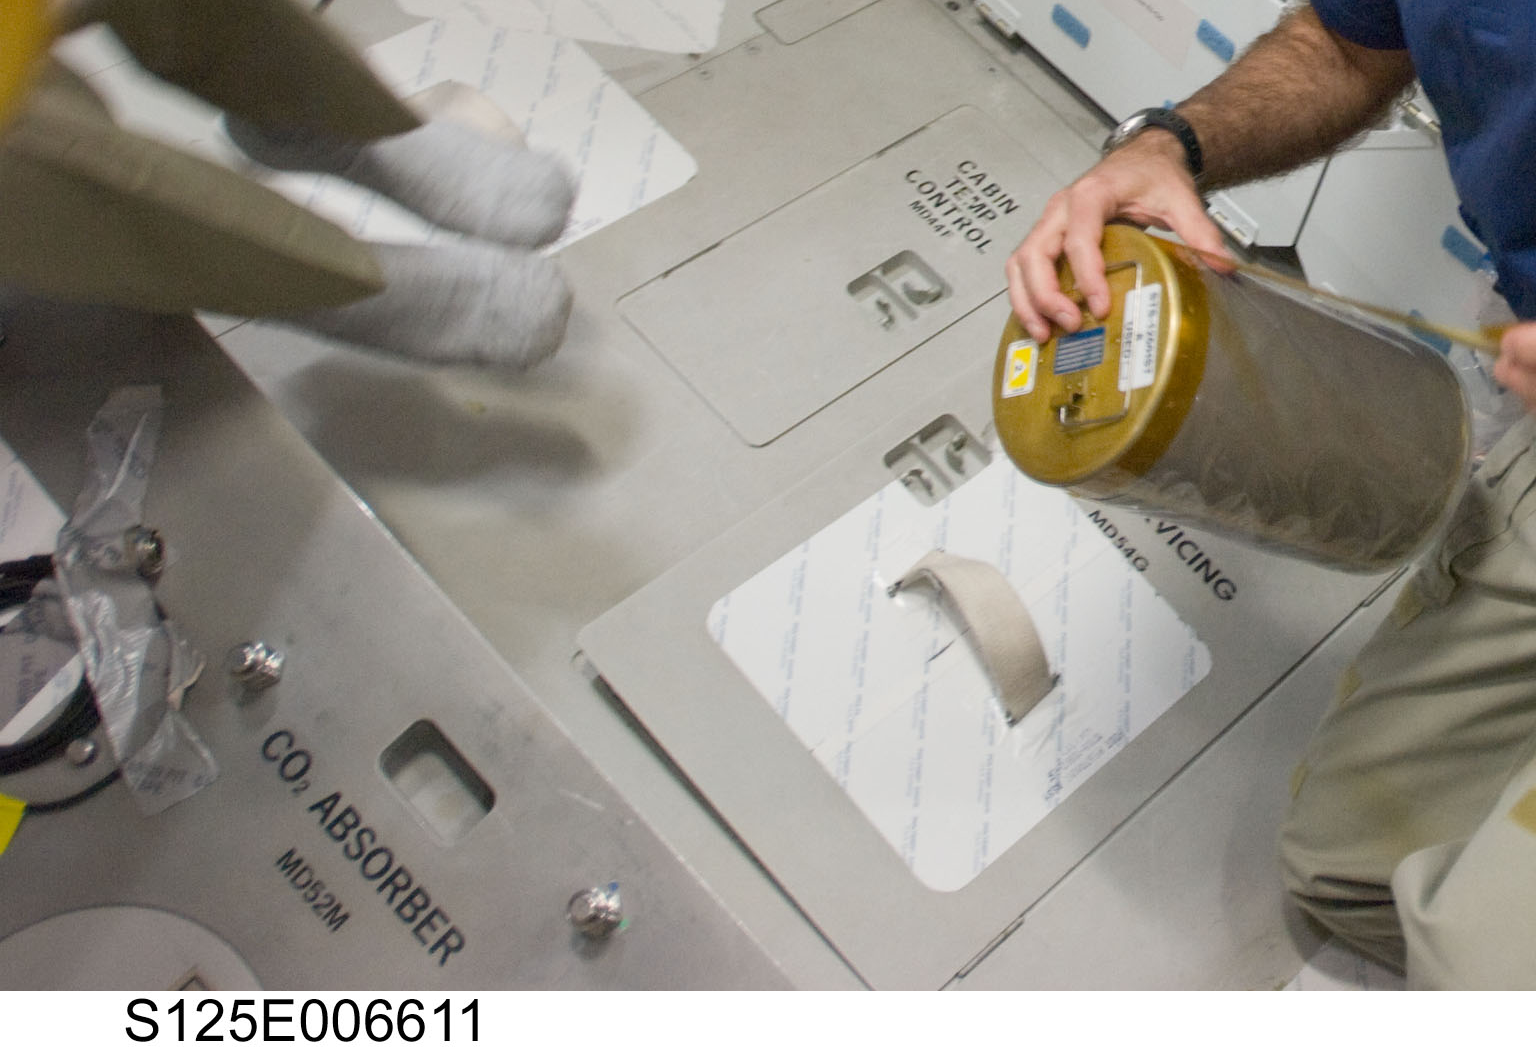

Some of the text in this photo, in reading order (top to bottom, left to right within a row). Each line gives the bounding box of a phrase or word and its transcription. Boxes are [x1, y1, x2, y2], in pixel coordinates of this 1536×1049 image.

[904, 169, 992, 254] CONTROL
[945, 177, 998, 222] TEMP
[957, 160, 1020, 215] CABIN
[1088, 509, 1150, 572] MD54G
[1146, 517, 1237, 601] VICING
[274, 847, 352, 933] MD52M
[307, 790, 467, 968] ABSORBER
